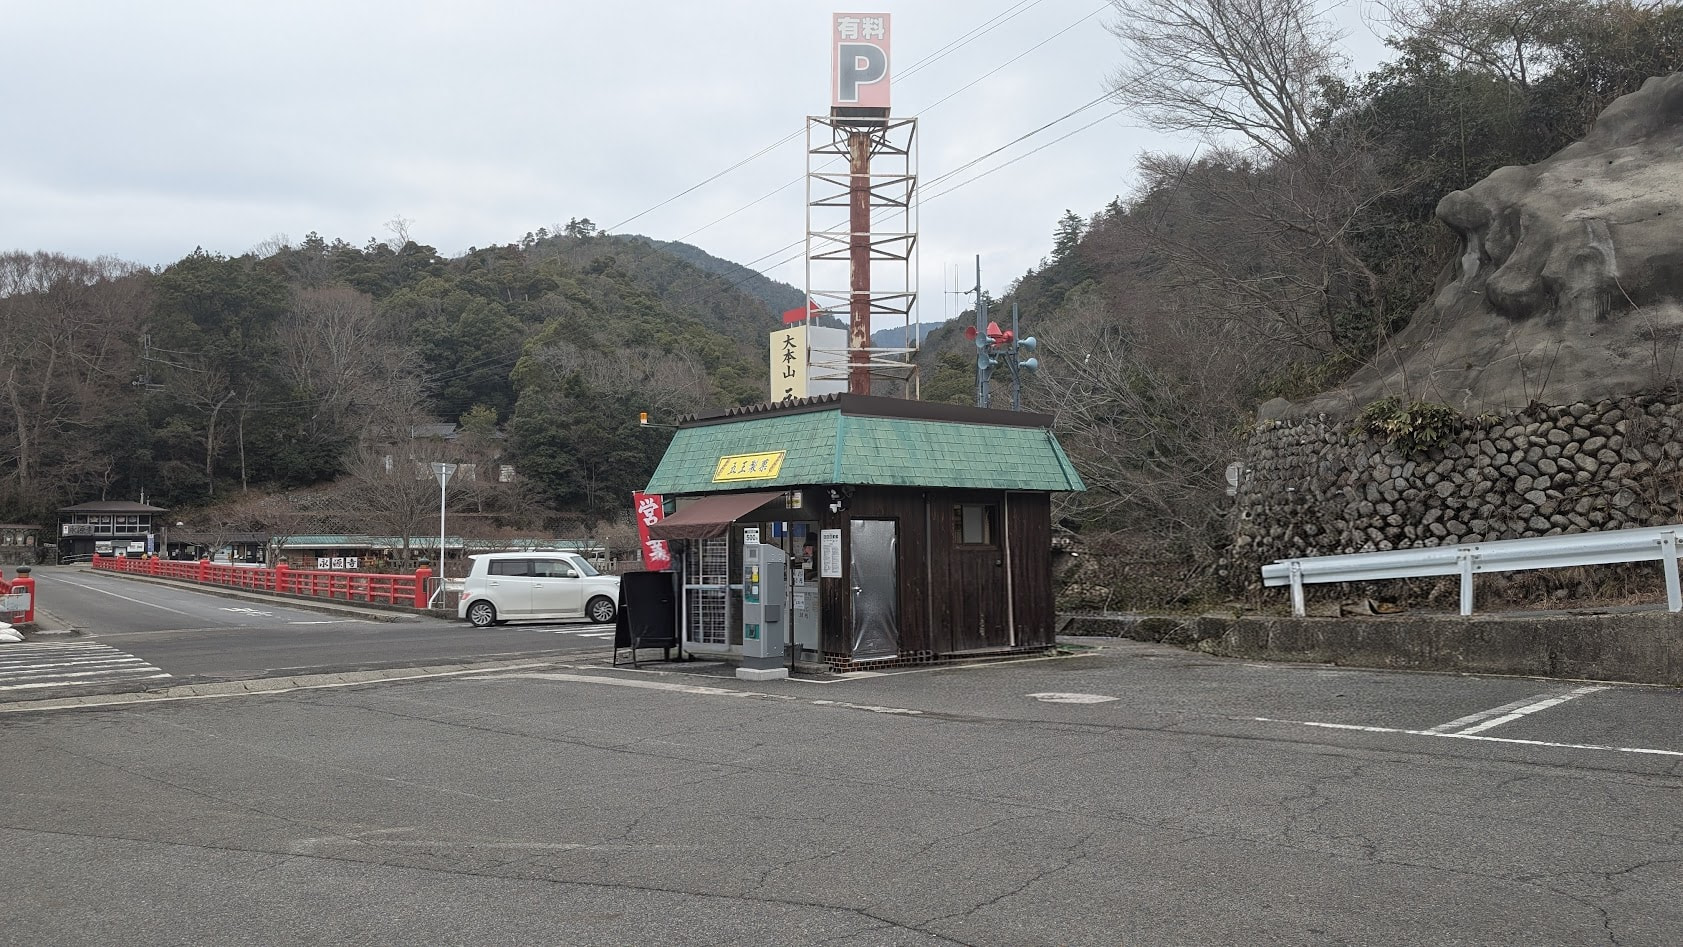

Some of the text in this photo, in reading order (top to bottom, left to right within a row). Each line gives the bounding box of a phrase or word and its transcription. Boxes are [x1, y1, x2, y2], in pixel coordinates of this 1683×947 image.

[837, 16, 885, 40] 有料
[838, 42, 888, 102] P
[782, 334, 798, 379] 大本山
[319, 558, 357, 568] 永源寺
